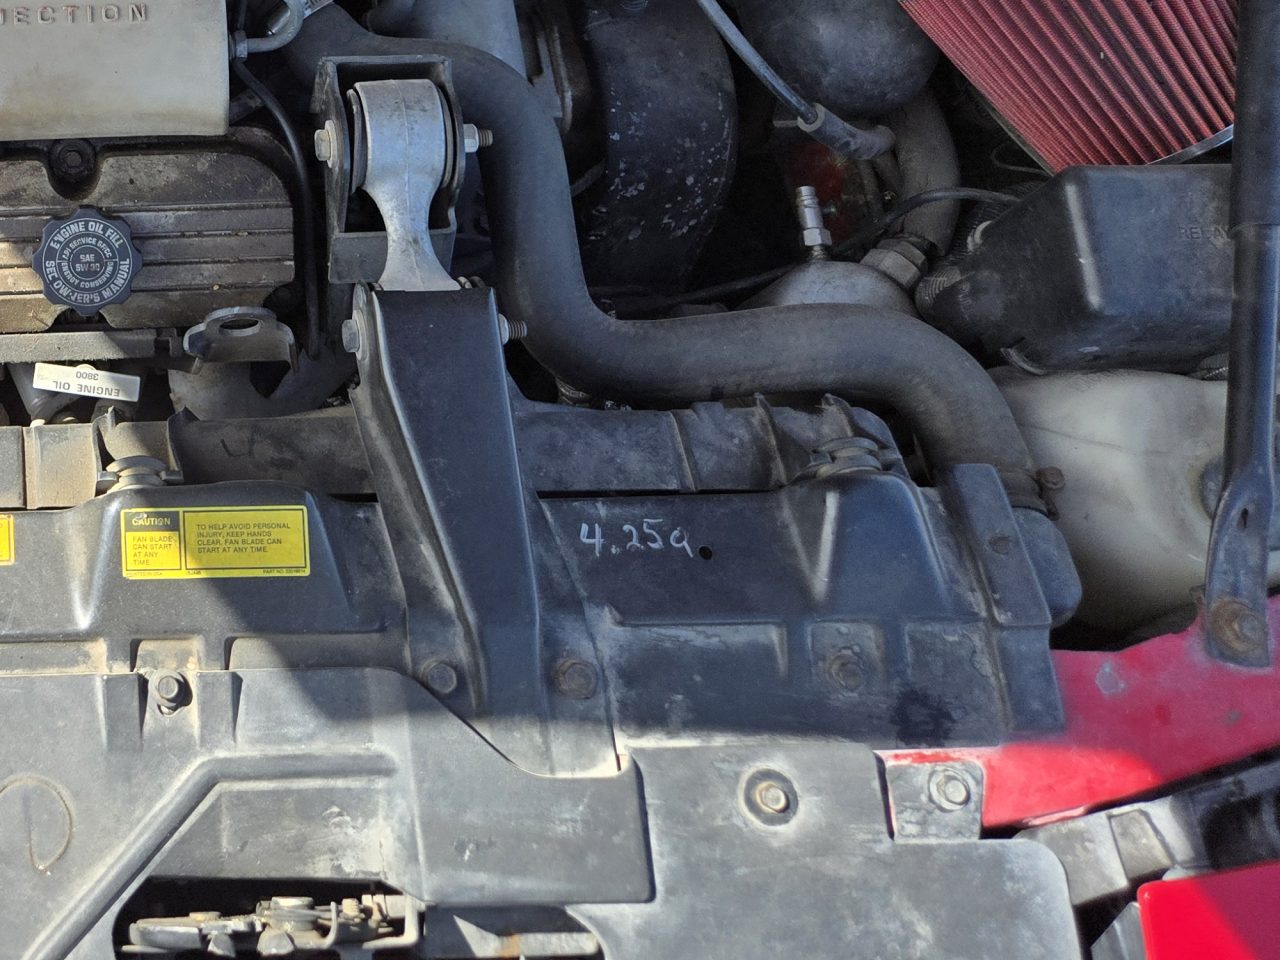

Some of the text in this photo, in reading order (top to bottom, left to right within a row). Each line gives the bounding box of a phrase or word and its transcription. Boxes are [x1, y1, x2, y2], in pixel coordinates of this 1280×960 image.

[50, 222, 123, 249] ENGINE OIL FILL
[80, 254, 94, 262] SAE
[61, 262, 113, 288] ENERGY CONSERVING
[102, 258, 129, 298] MANUAL
[76, 371, 99, 381] 3800
[53, 381, 120, 397] ENGINE OIL
